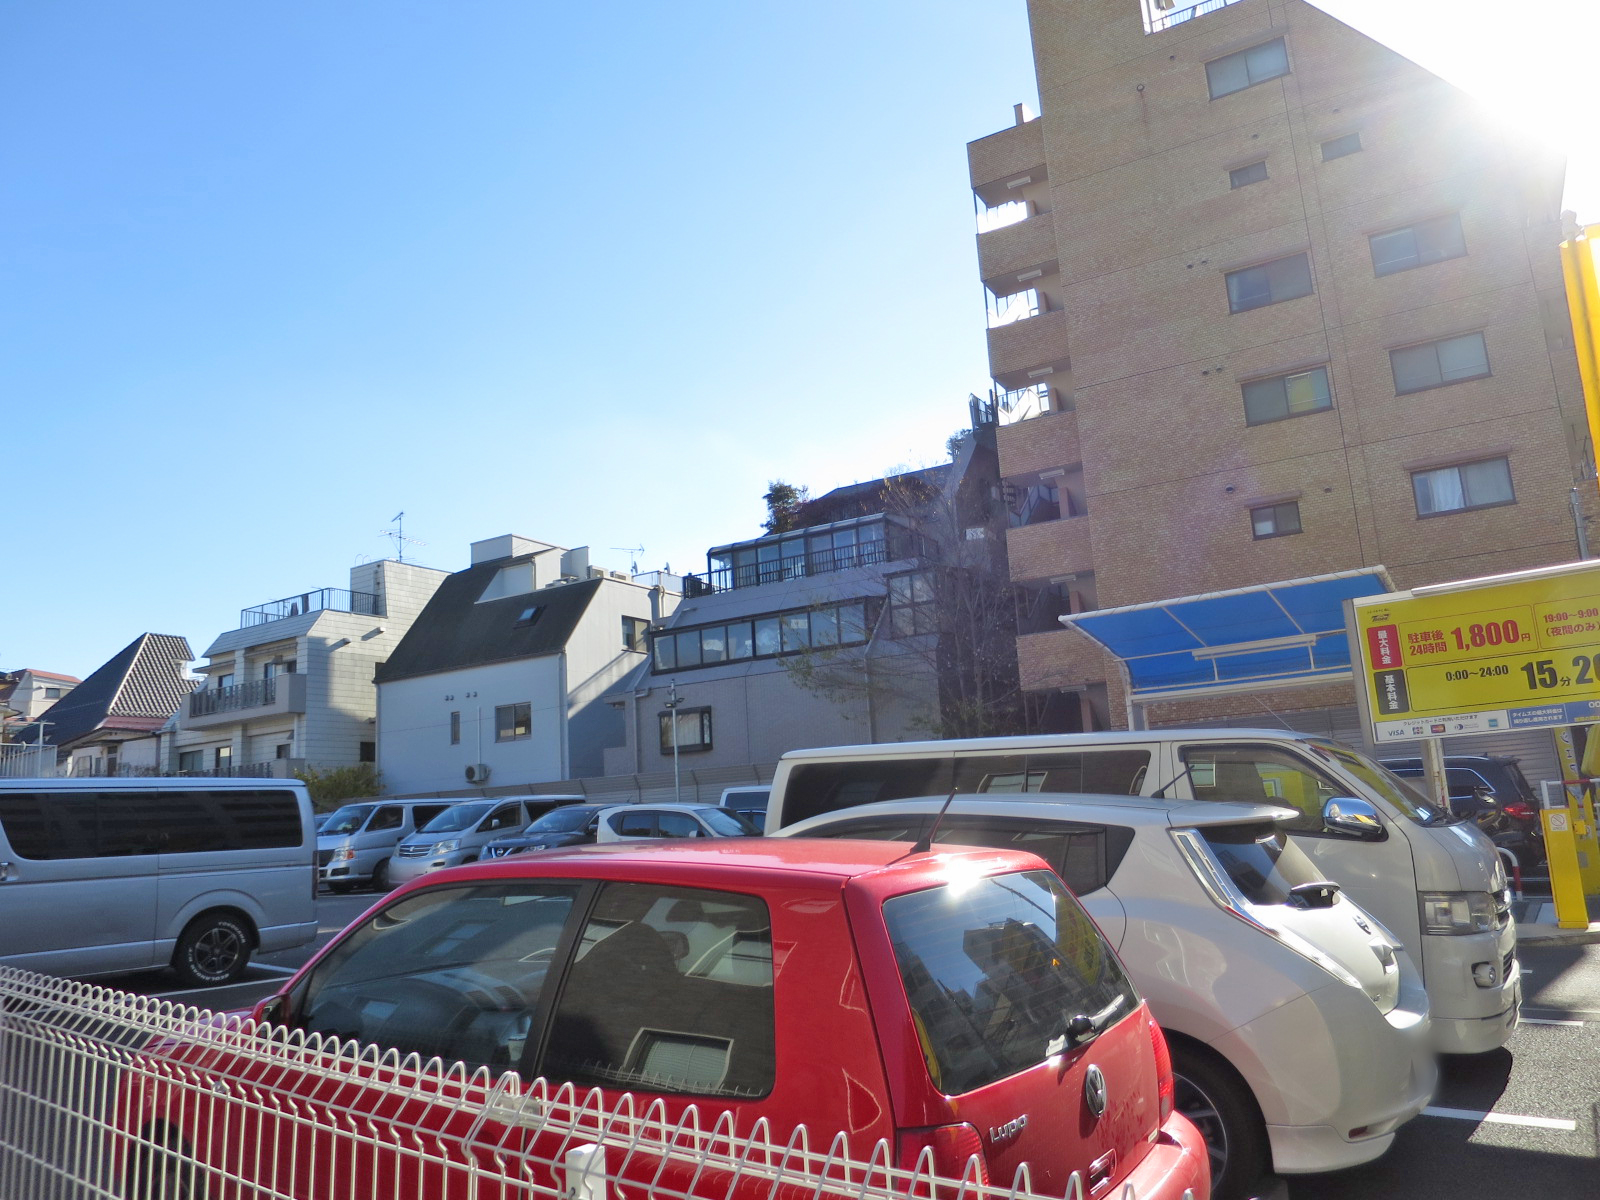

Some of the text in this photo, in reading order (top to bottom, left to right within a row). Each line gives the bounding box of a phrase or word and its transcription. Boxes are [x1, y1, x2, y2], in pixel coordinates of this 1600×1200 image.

[1377, 630, 1392, 664] 最大料金
[1407, 629, 1444, 644] 駐車後
[1409, 641, 1447, 656] 24時間
[1384, 674, 1399, 710] 基本料金
[1388, 729, 1405, 737] VISA
[989, 1113, 1029, 1143] Lupo
